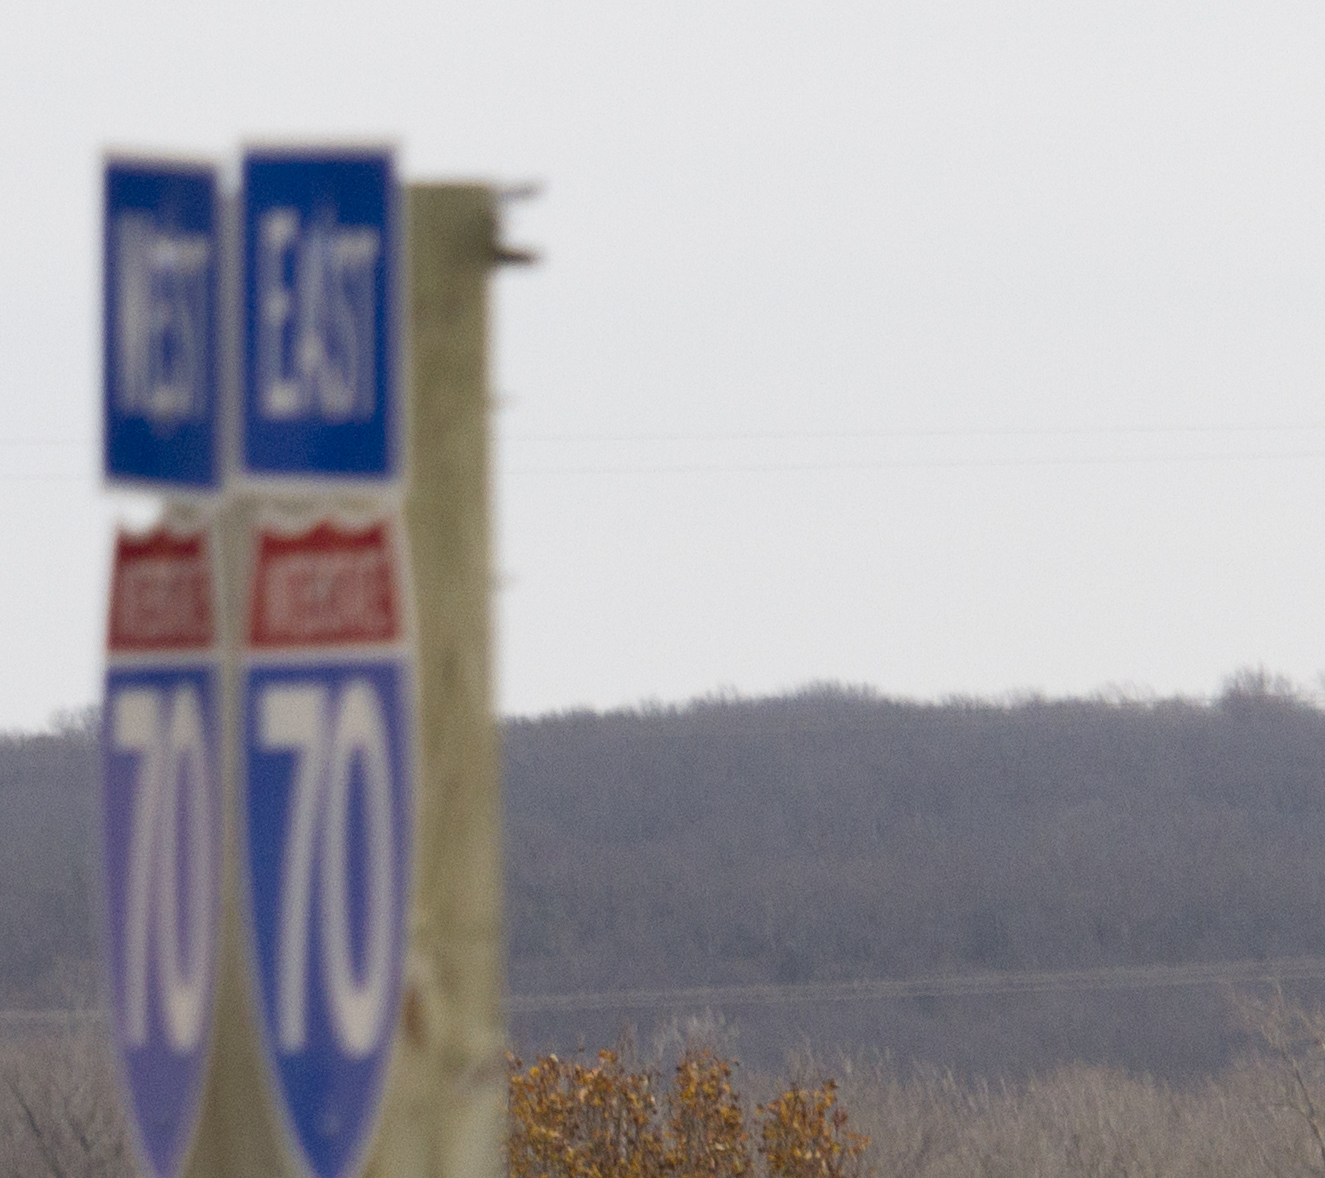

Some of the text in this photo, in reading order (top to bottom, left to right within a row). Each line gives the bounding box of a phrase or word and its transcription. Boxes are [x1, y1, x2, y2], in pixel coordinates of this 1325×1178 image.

[259, 205, 380, 421] EAST
[113, 685, 210, 1056] 70
[261, 678, 393, 1057] 70
